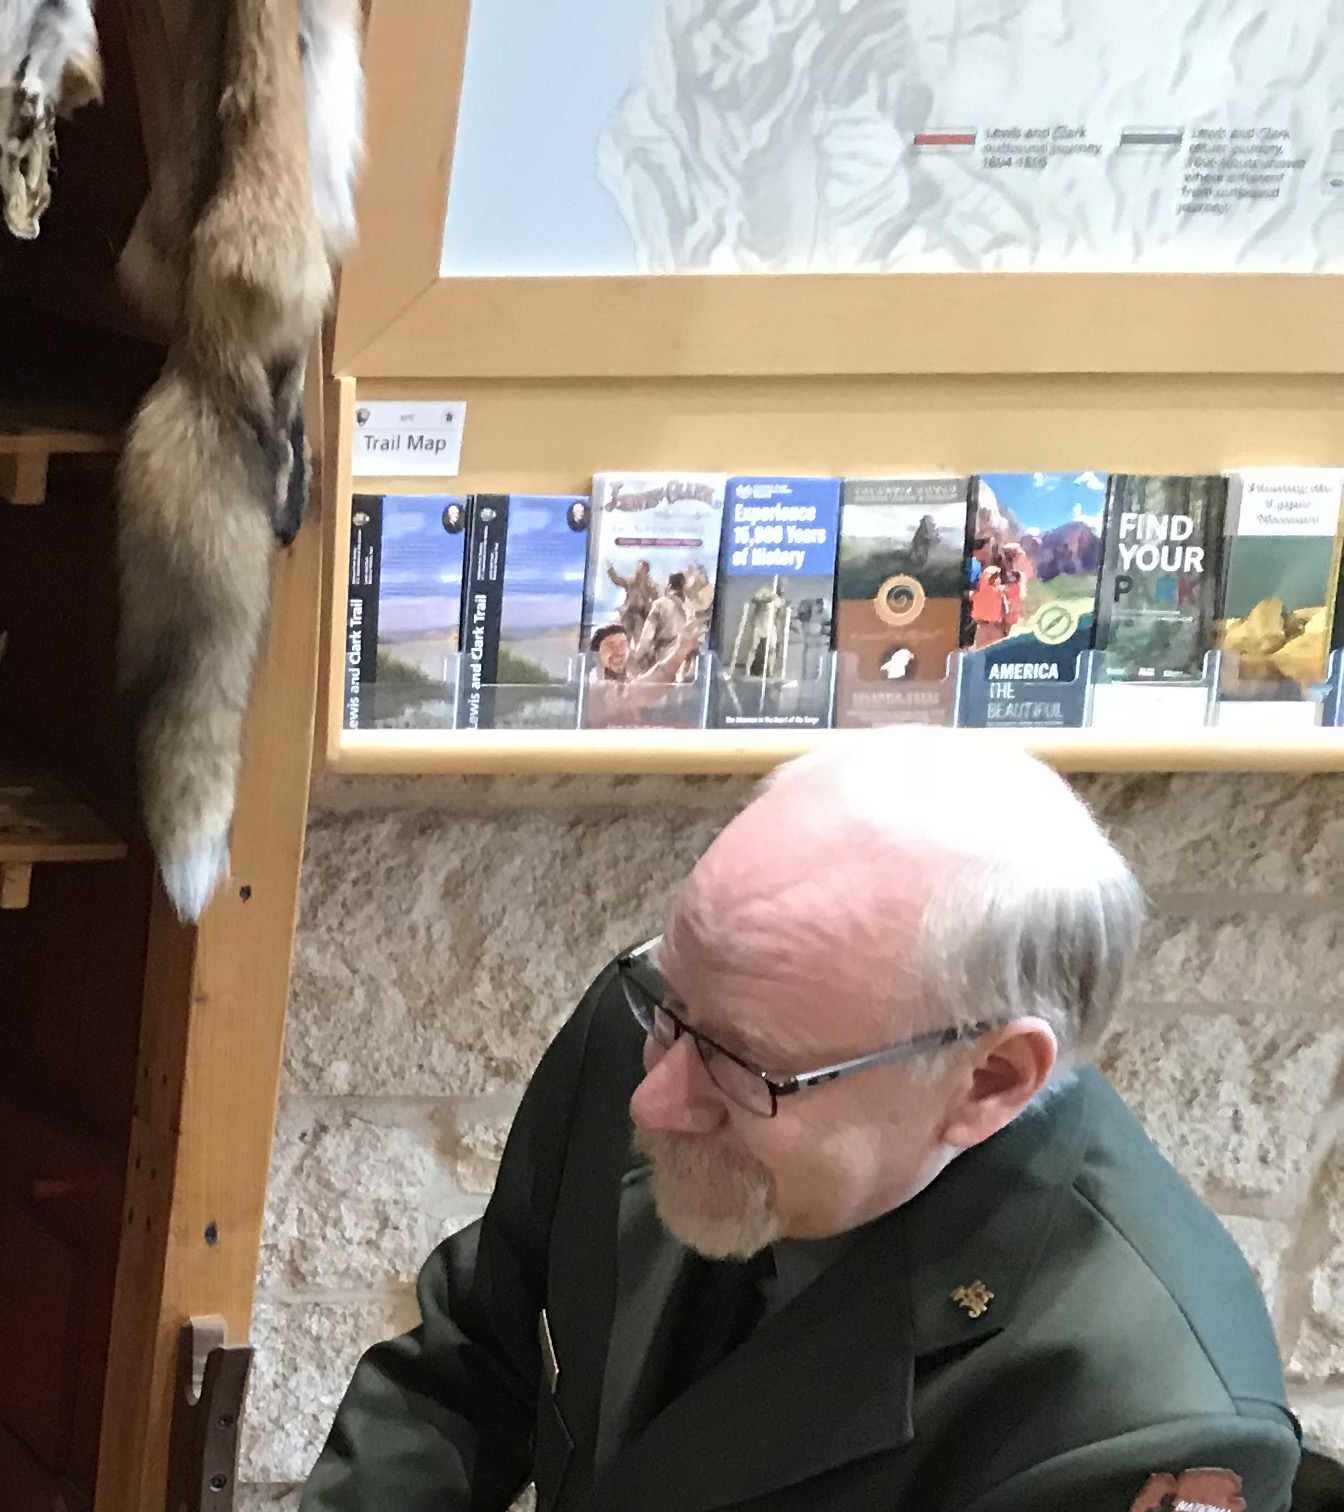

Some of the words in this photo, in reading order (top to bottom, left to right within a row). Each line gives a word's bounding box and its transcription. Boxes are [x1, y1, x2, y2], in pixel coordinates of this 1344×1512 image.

[364, 434, 402, 452] Trail
[407, 434, 447, 456] Map
[734, 502, 816, 526] Experience
[1119, 512, 1194, 541] FIND
[786, 525, 827, 545] Years
[732, 547, 750, 567] of
[751, 547, 806, 570] History
[1118, 543, 1205, 573] YOUR
[1114, 574, 1197, 603] PK
[349, 598, 363, 628] Trail
[474, 594, 487, 623] Trail
[349, 629, 362, 665] Clark
[472, 625, 486, 660] Clark
[348, 667, 361, 695] and
[470, 663, 482, 691] and
[988, 662, 1059, 680] AMERICA
[989, 681, 1016, 699] THE
[346, 696, 360, 729] ewis
[987, 701, 1064, 719] BEAUTIFUL
